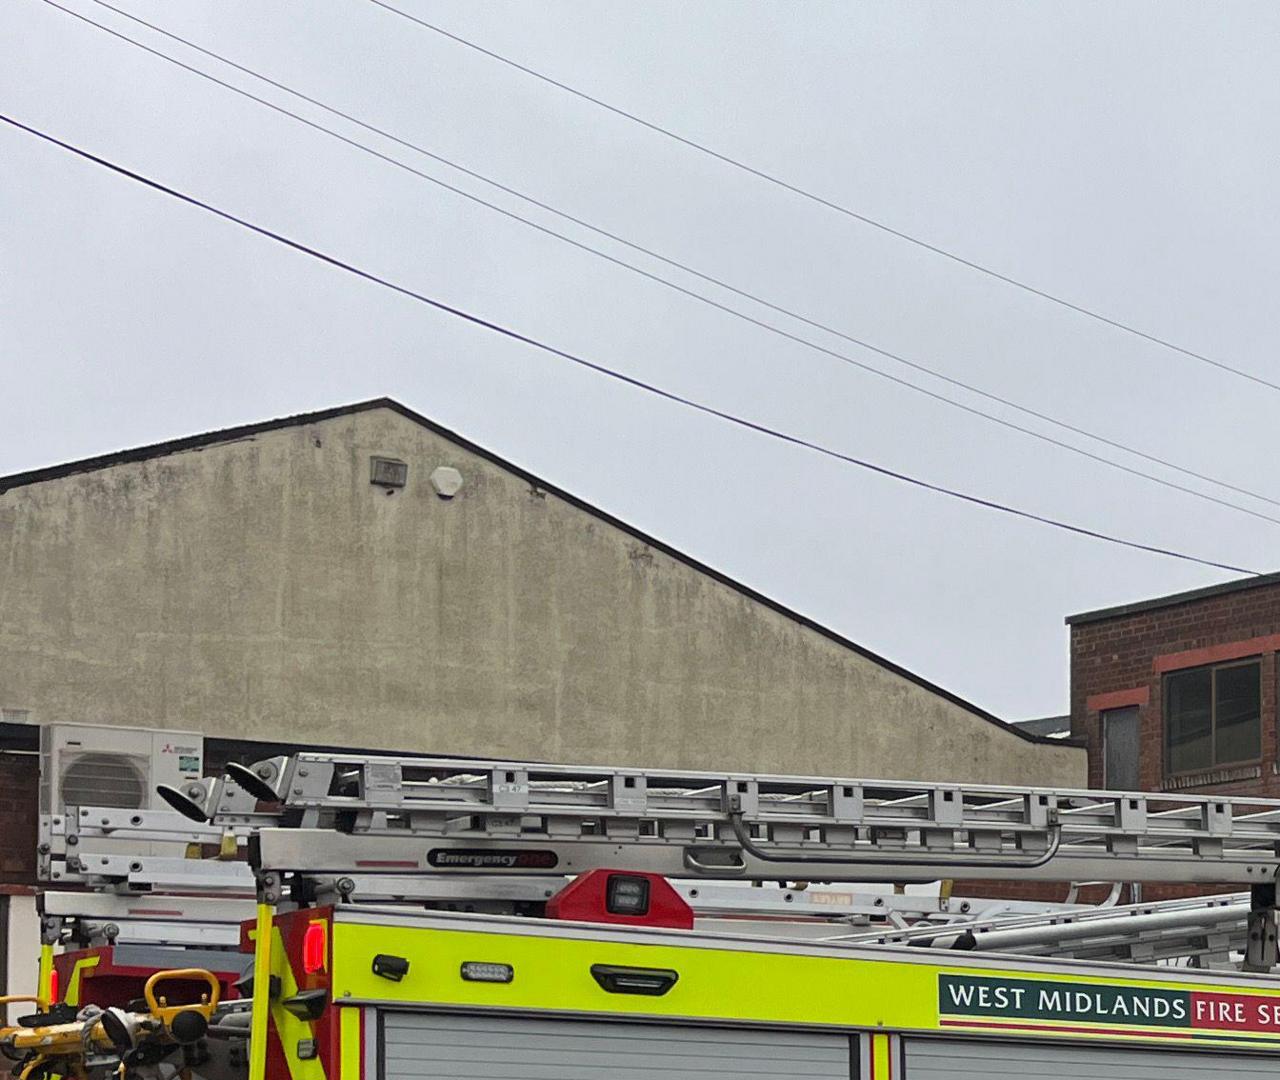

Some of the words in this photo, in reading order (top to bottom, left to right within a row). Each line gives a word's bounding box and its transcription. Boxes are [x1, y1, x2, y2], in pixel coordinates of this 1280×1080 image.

[436, 851, 517, 867] Emergency
[948, 983, 1025, 1009] WEST
[1038, 989, 1186, 1019] MIDLANDS
[1196, 1000, 1247, 1023] FIRE
